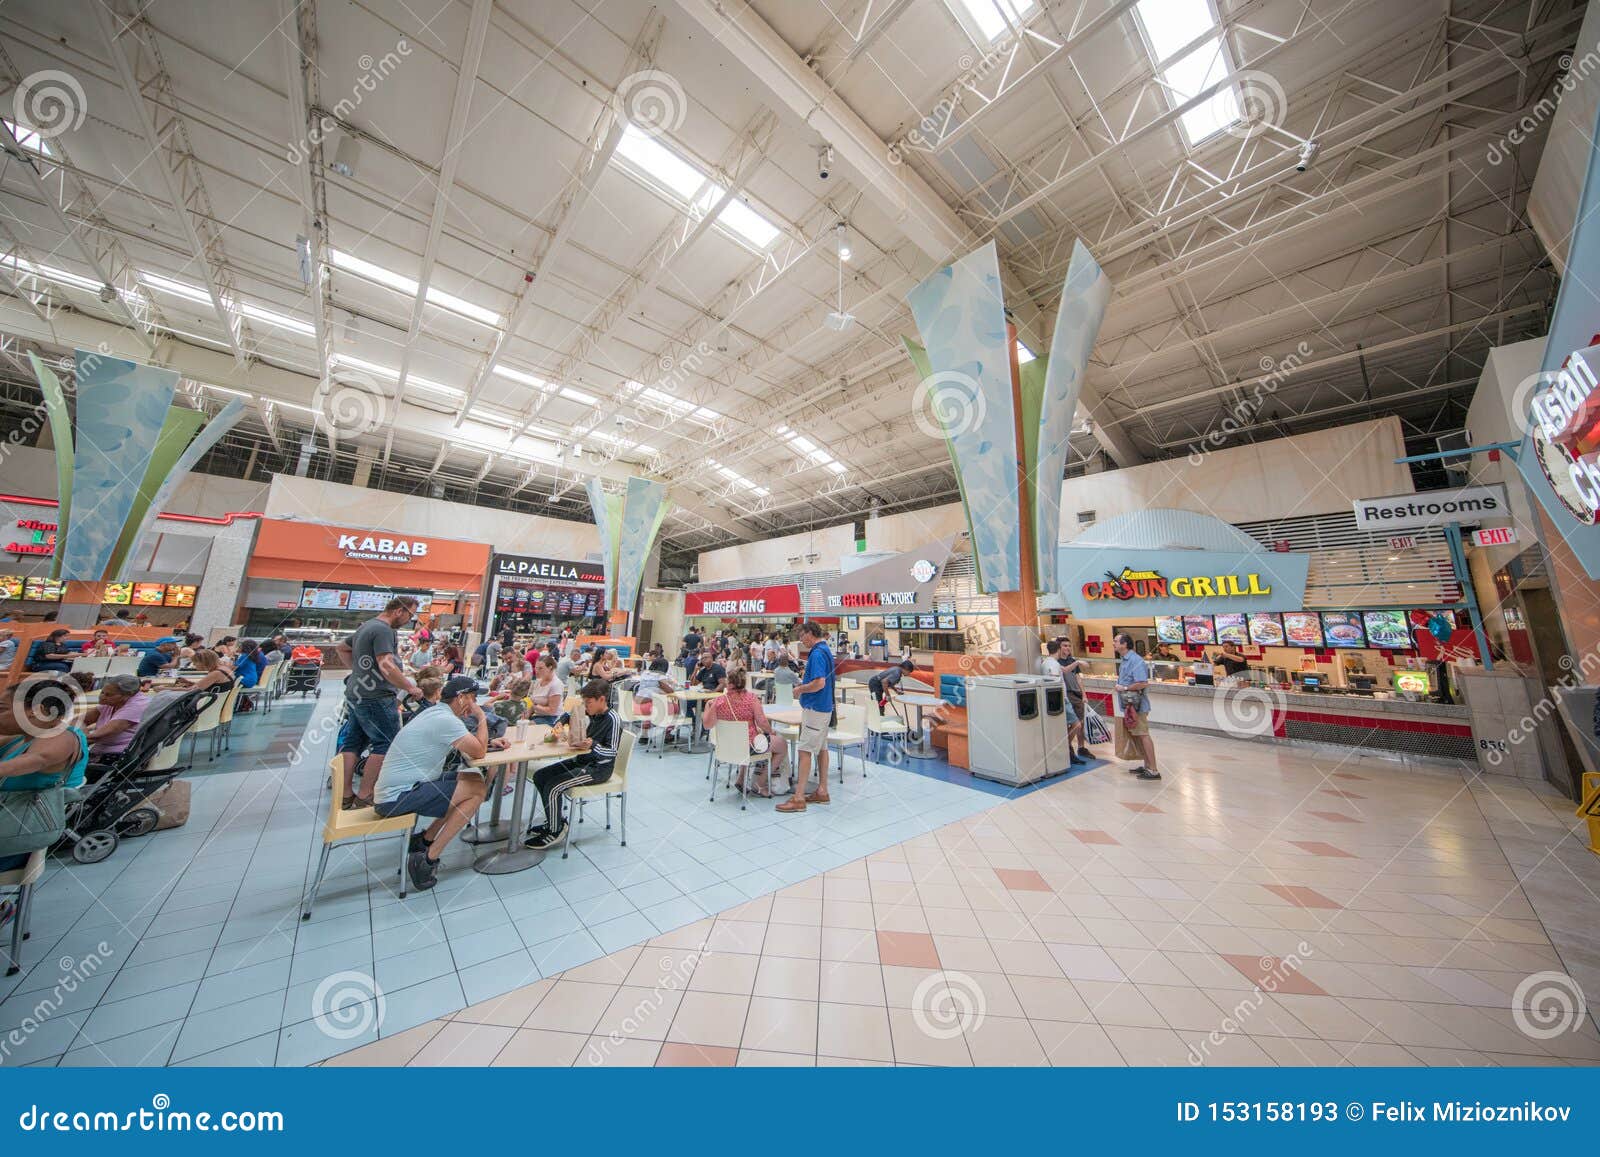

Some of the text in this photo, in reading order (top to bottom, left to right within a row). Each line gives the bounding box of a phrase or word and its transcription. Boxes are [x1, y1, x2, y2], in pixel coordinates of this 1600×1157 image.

[1531, 351, 1599, 444] Asian
[1569, 455, 1600, 511] Ch
[1364, 497, 1497, 521] Restrooms
[338, 534, 428, 556] KABAB
[1391, 536, 1412, 549] EXIT
[1479, 528, 1510, 544] EXIT
[500, 560, 516, 570] LA
[518, 561, 578, 579] PAELLA
[1081, 573, 1272, 601] CAJUN GRILL
[703, 599, 766, 614] BURGER KING
[827, 591, 916, 608] THE GRILL FACTORY
